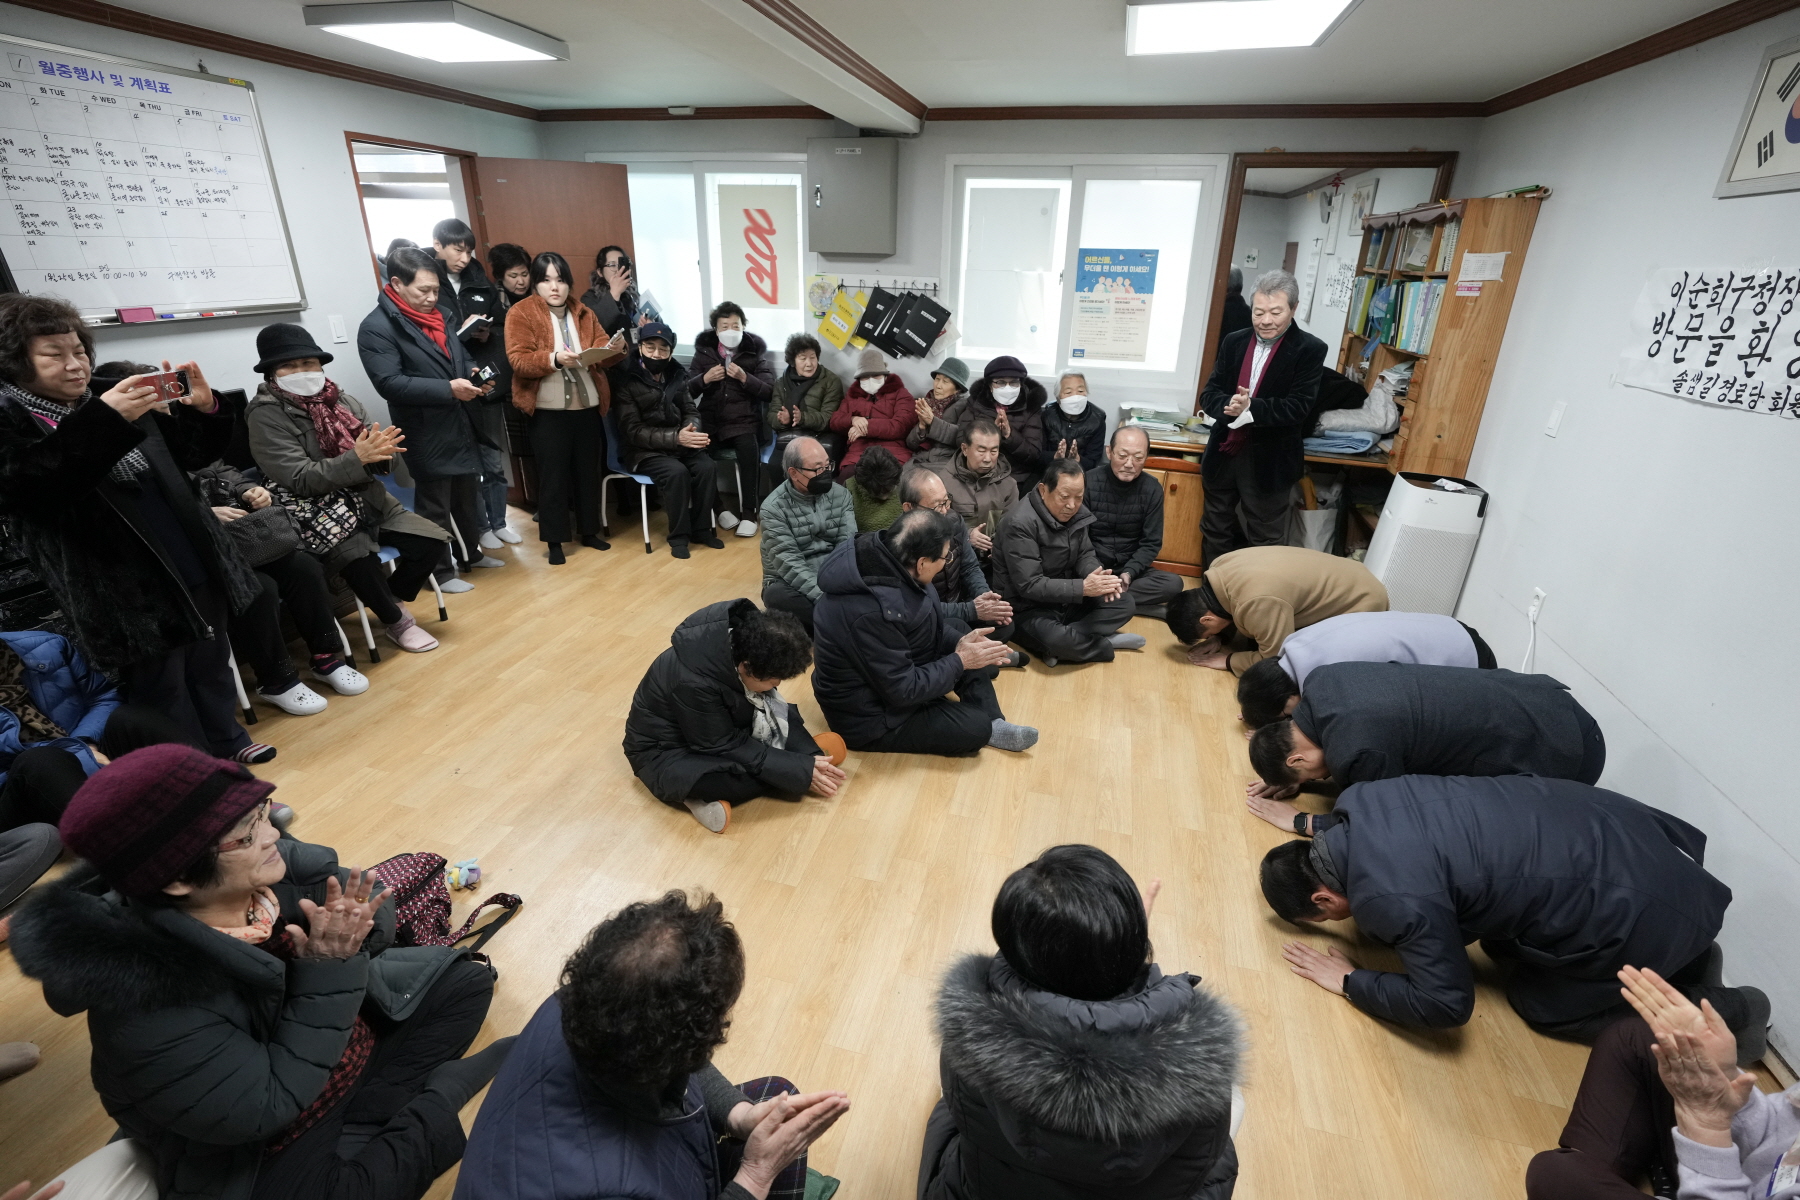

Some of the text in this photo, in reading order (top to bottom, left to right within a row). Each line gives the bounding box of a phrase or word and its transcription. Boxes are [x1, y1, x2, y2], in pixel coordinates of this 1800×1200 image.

[38, 60, 172, 94] 월중행사 및 계획표
[39, 87, 66, 97] 화 TUE
[91, 94, 117, 105] 수 WED
[148, 103, 162, 111] THU
[201, 269, 217, 279] 방문
